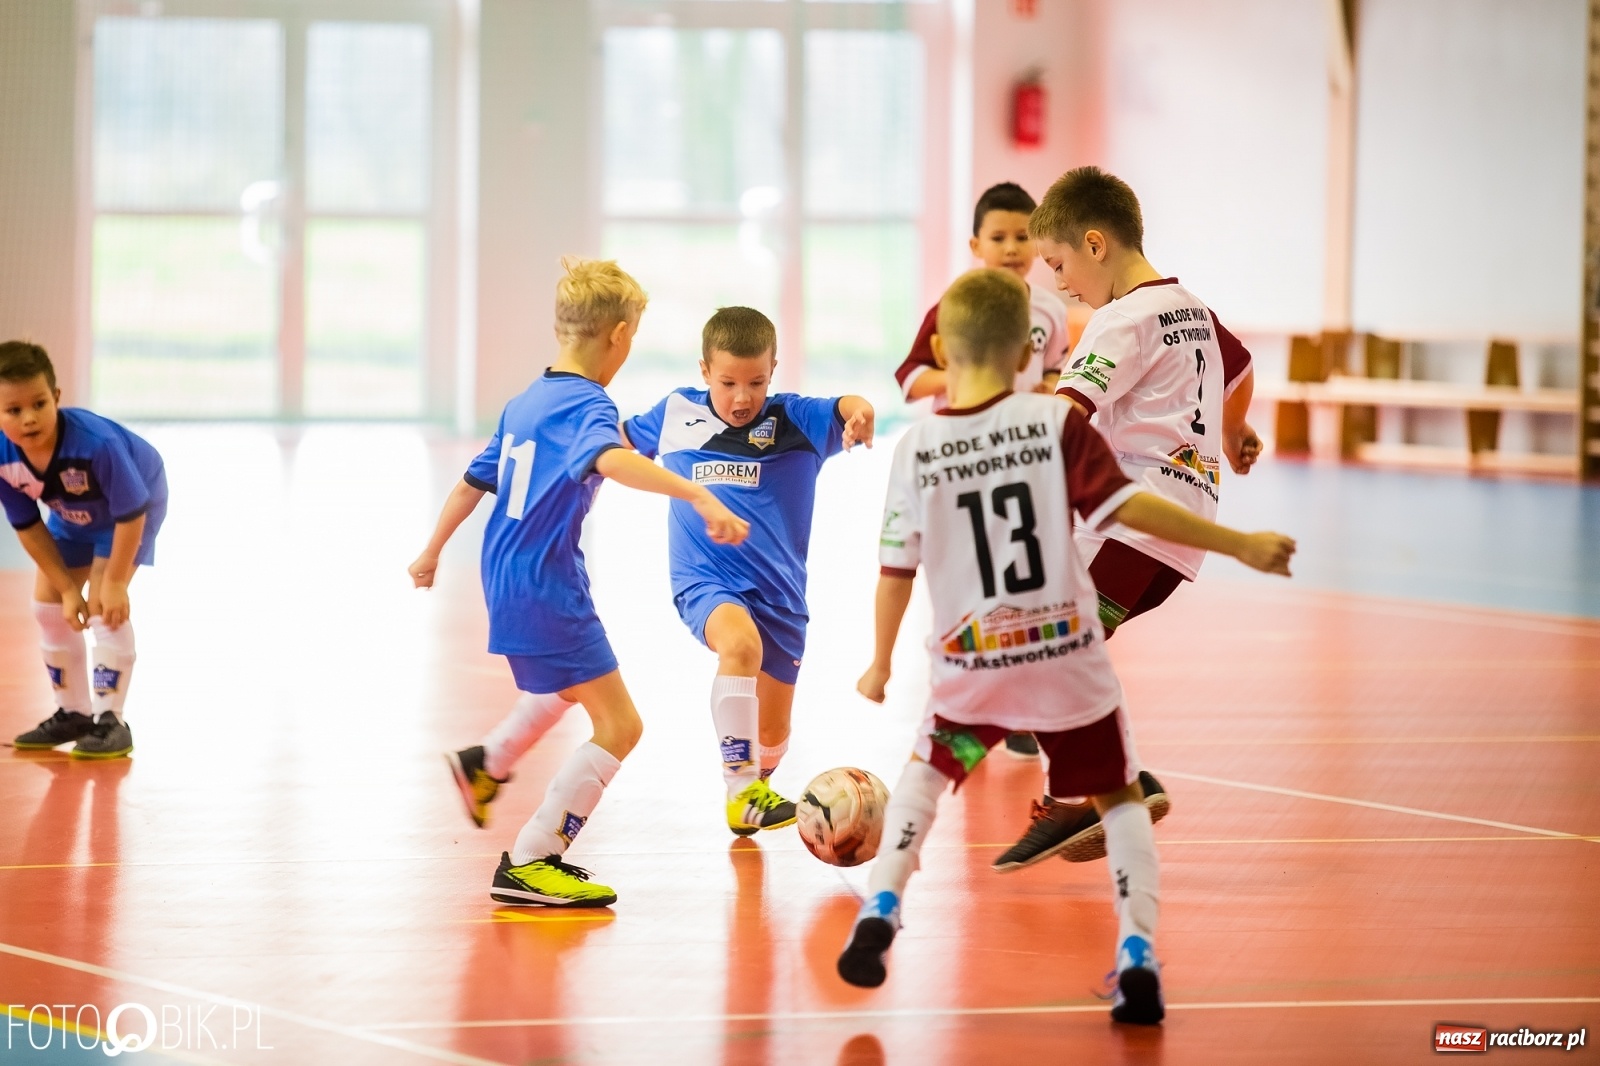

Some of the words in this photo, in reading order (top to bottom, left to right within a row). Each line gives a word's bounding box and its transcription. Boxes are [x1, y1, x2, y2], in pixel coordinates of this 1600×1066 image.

[1158, 308, 1192, 328] MŁODE
[754, 430, 770, 438] GOL
[989, 423, 1047, 447] WILKI
[695, 463, 758, 480] EDOREM
[944, 443, 1052, 483] TWORKÓW
[957, 481, 1047, 599] 13
